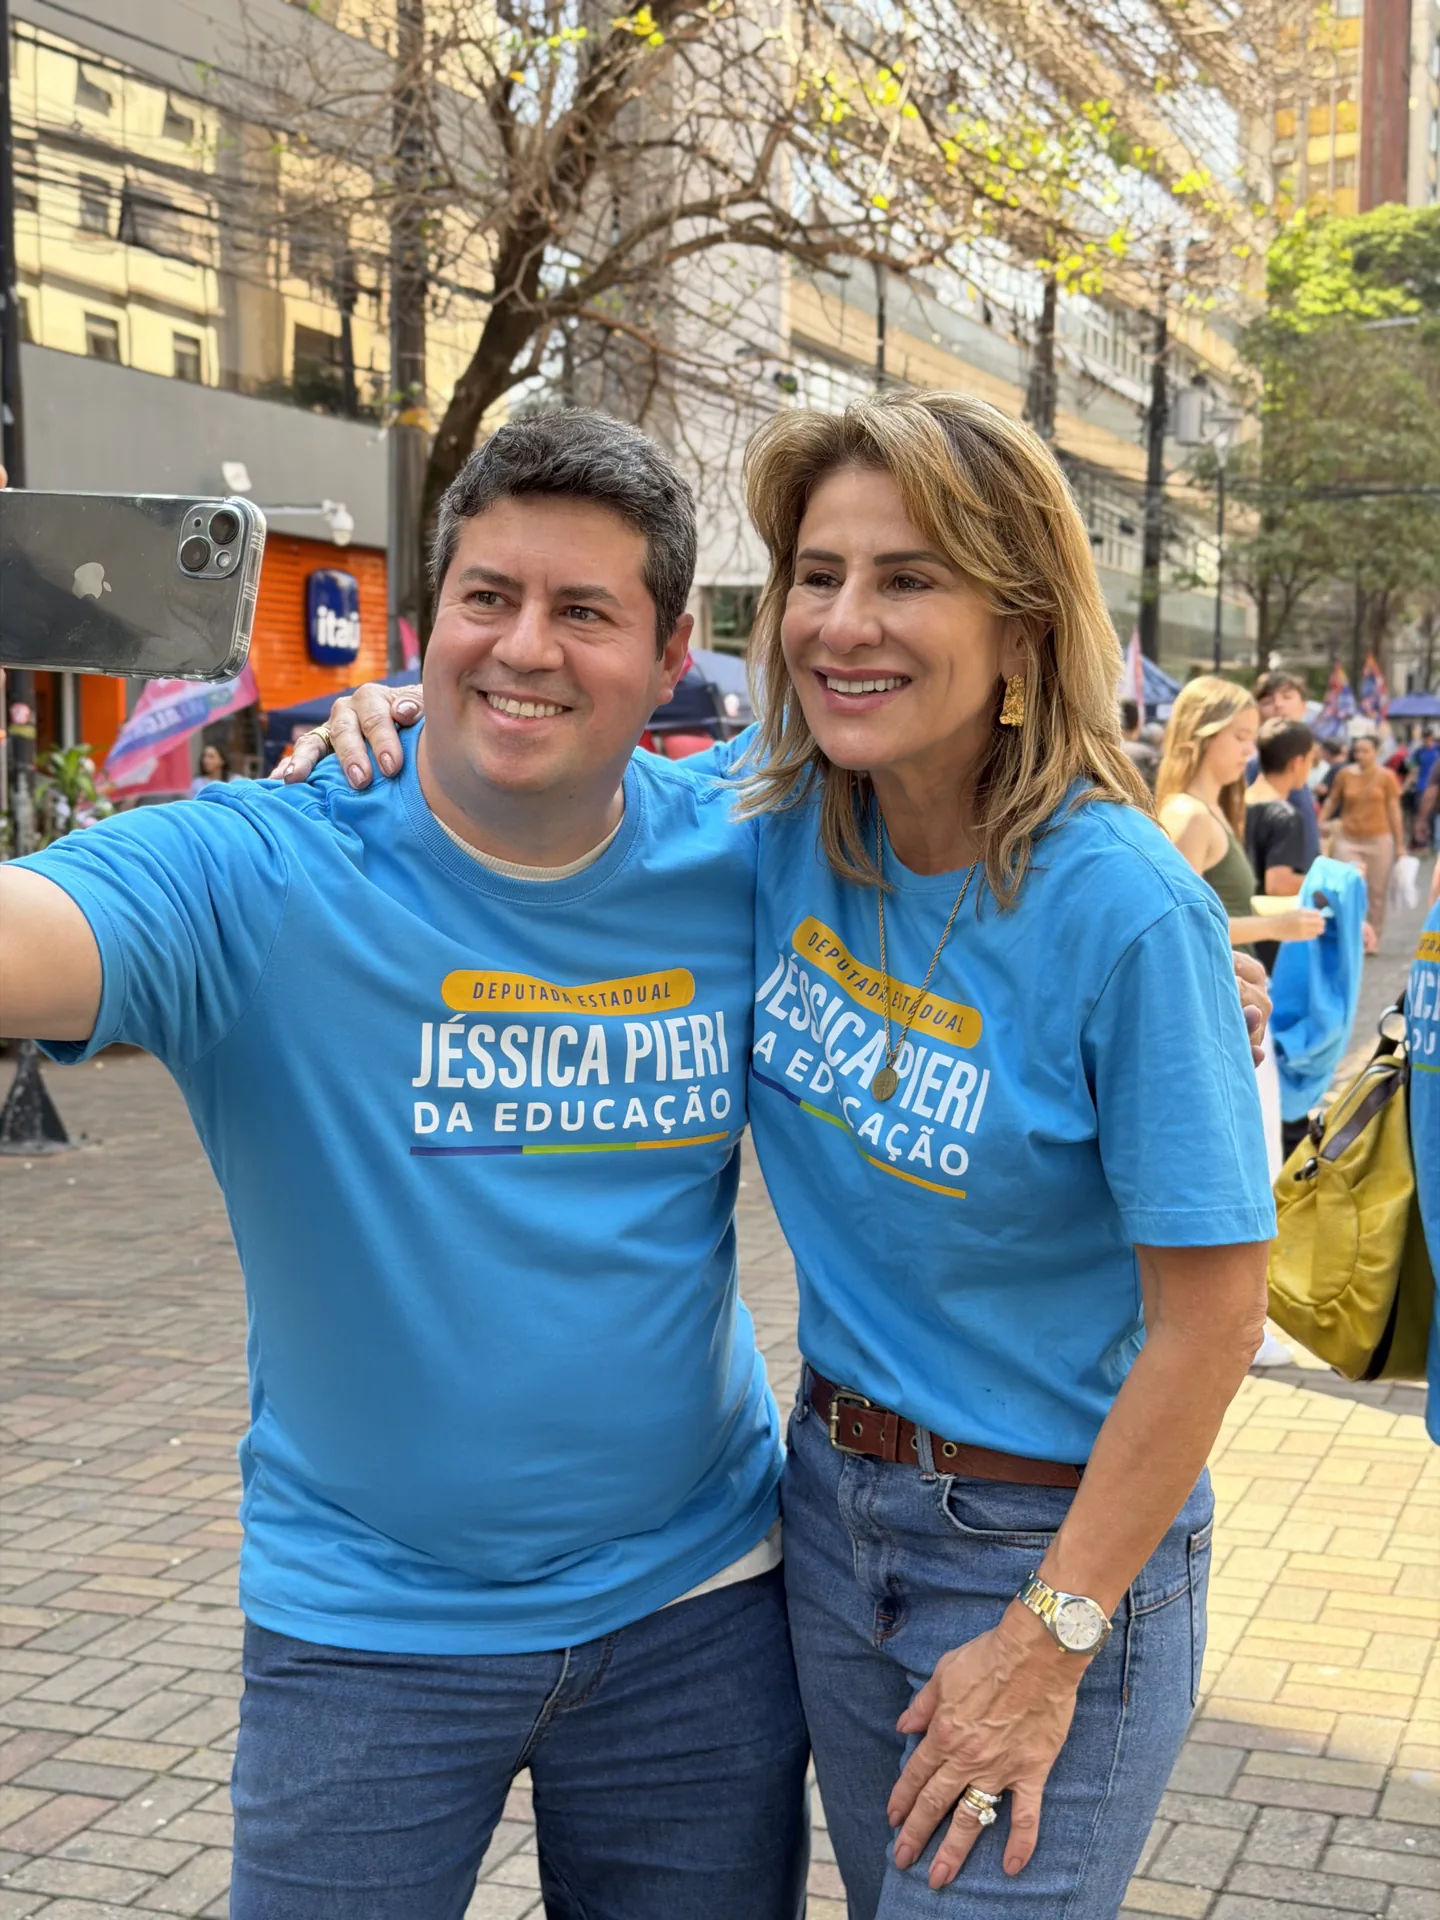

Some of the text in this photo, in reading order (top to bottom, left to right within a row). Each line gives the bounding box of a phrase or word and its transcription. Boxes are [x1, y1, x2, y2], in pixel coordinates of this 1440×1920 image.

[473, 981, 671, 1008] DEPUTADA ESTADUAL
[808, 931, 889, 1002] DEPUTADA
[412, 1011, 729, 1089] JÉSSICA PIERI
[755, 952, 991, 1134] JÉSSICA PIERI
[413, 1084, 731, 1134] DA EDUCAÇÃO
[753, 1030, 969, 1176] A EDCAÇÃO
